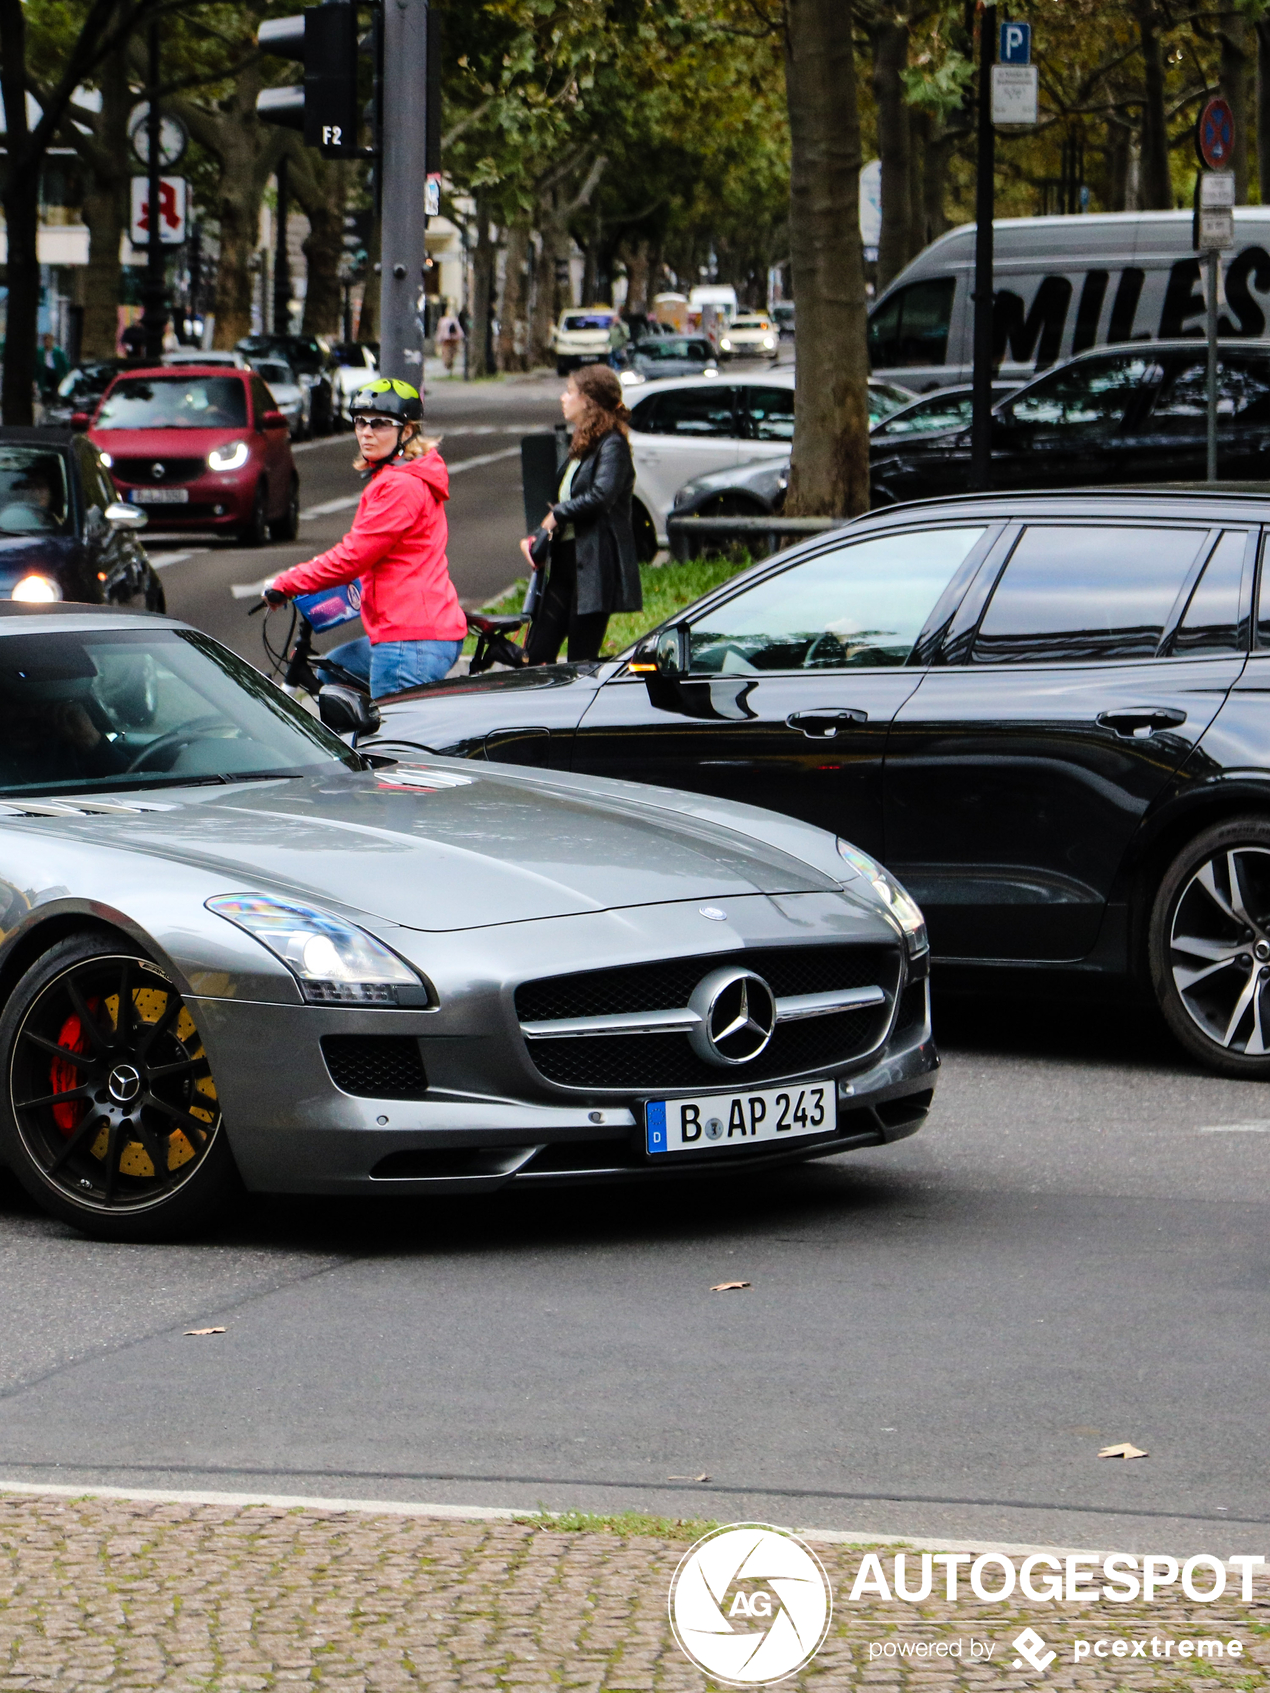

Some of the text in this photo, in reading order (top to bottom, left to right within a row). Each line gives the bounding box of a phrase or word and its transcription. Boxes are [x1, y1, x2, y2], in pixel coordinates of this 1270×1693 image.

[1006, 26, 1024, 60] P
[322, 125, 342, 146] F2
[992, 246, 1270, 378] MILES
[680, 1088, 825, 1143] B AP 243
[653, 1131, 661, 1143] D
